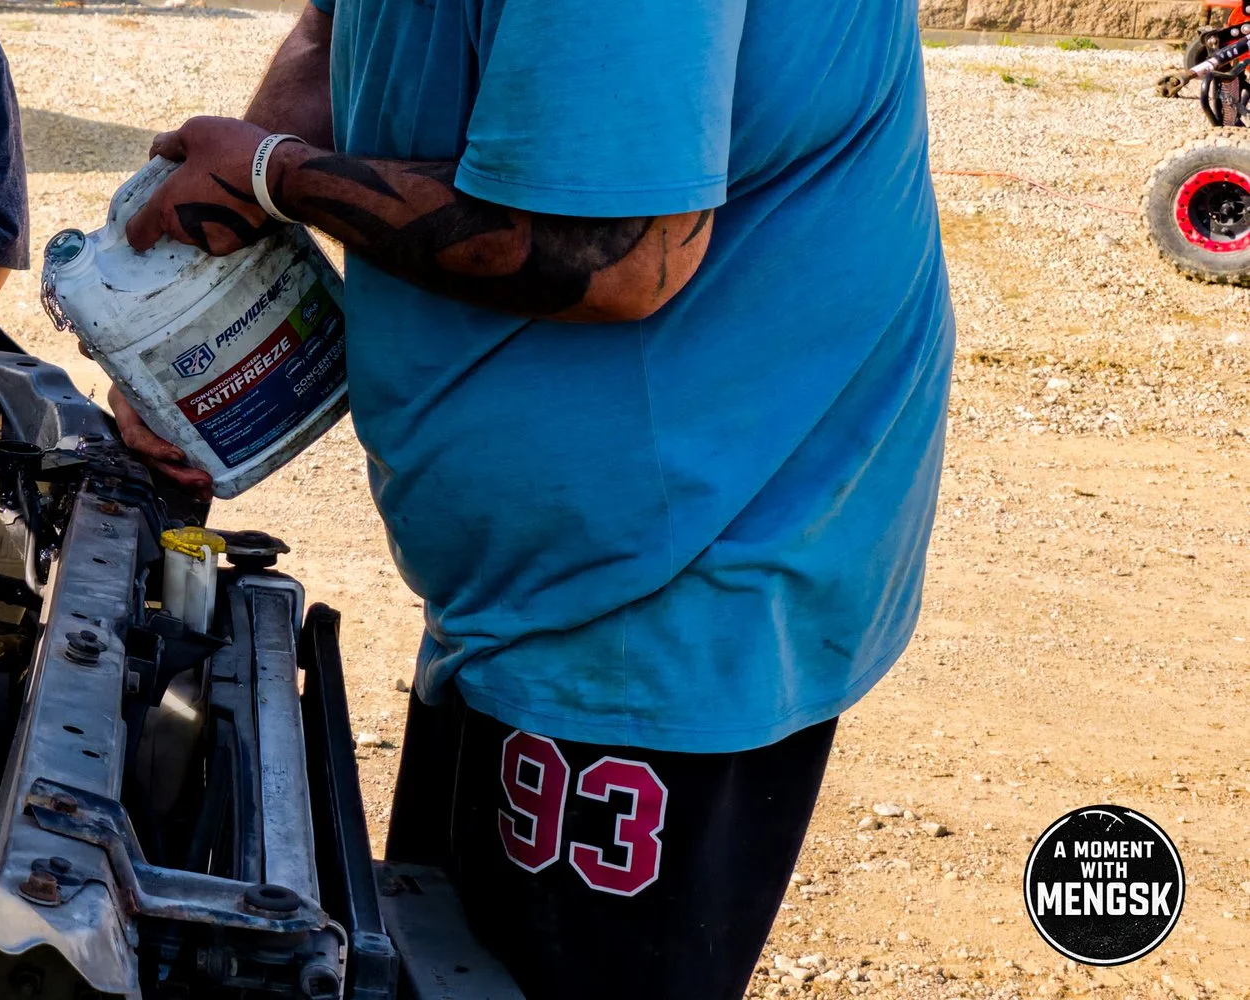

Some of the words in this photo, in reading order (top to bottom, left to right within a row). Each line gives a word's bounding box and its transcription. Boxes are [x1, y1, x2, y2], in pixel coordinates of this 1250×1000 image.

[254, 138, 274, 177] CHURCH
[190, 370, 241, 405] CONVENTIONAL
[241, 353, 262, 372] GREEN
[197, 336, 291, 415] ANTIFREEZE
[498, 729, 669, 897] 93
